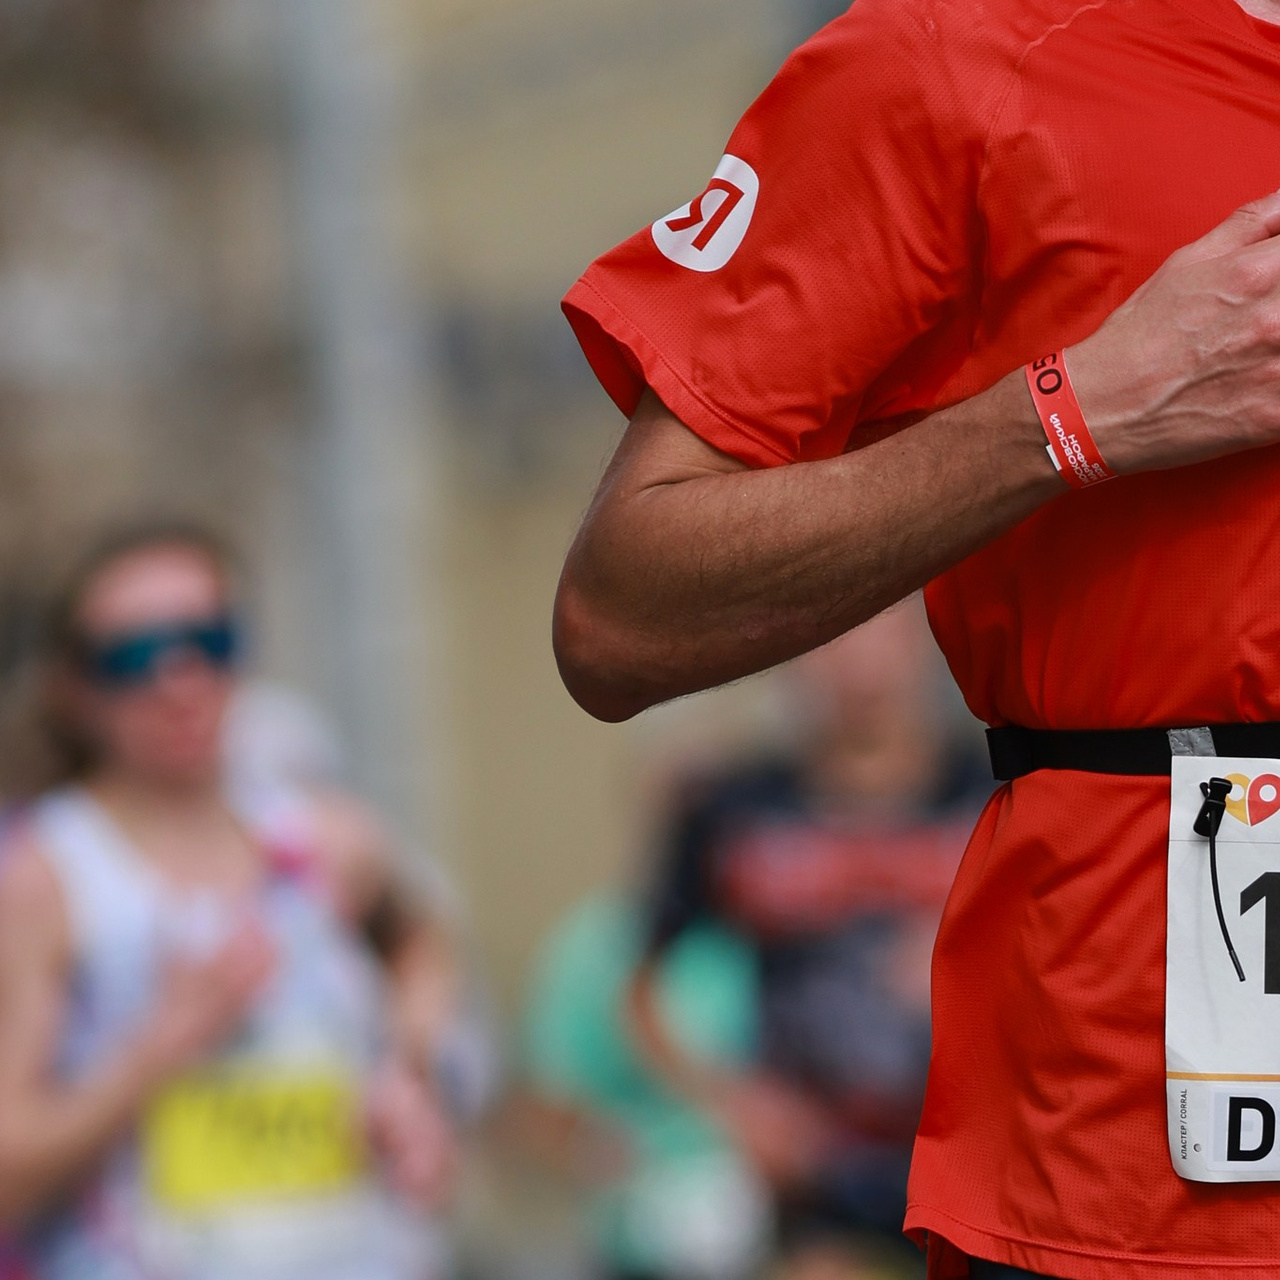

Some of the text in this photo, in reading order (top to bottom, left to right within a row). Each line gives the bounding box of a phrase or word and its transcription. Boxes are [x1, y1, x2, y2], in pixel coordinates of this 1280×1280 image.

[665, 177, 745, 252] Я
[1180, 1089, 1188, 1119] CORRAL
[1180, 1124, 1188, 1160] КЛАСТЕР
[1226, 1097, 1276, 1162] D
